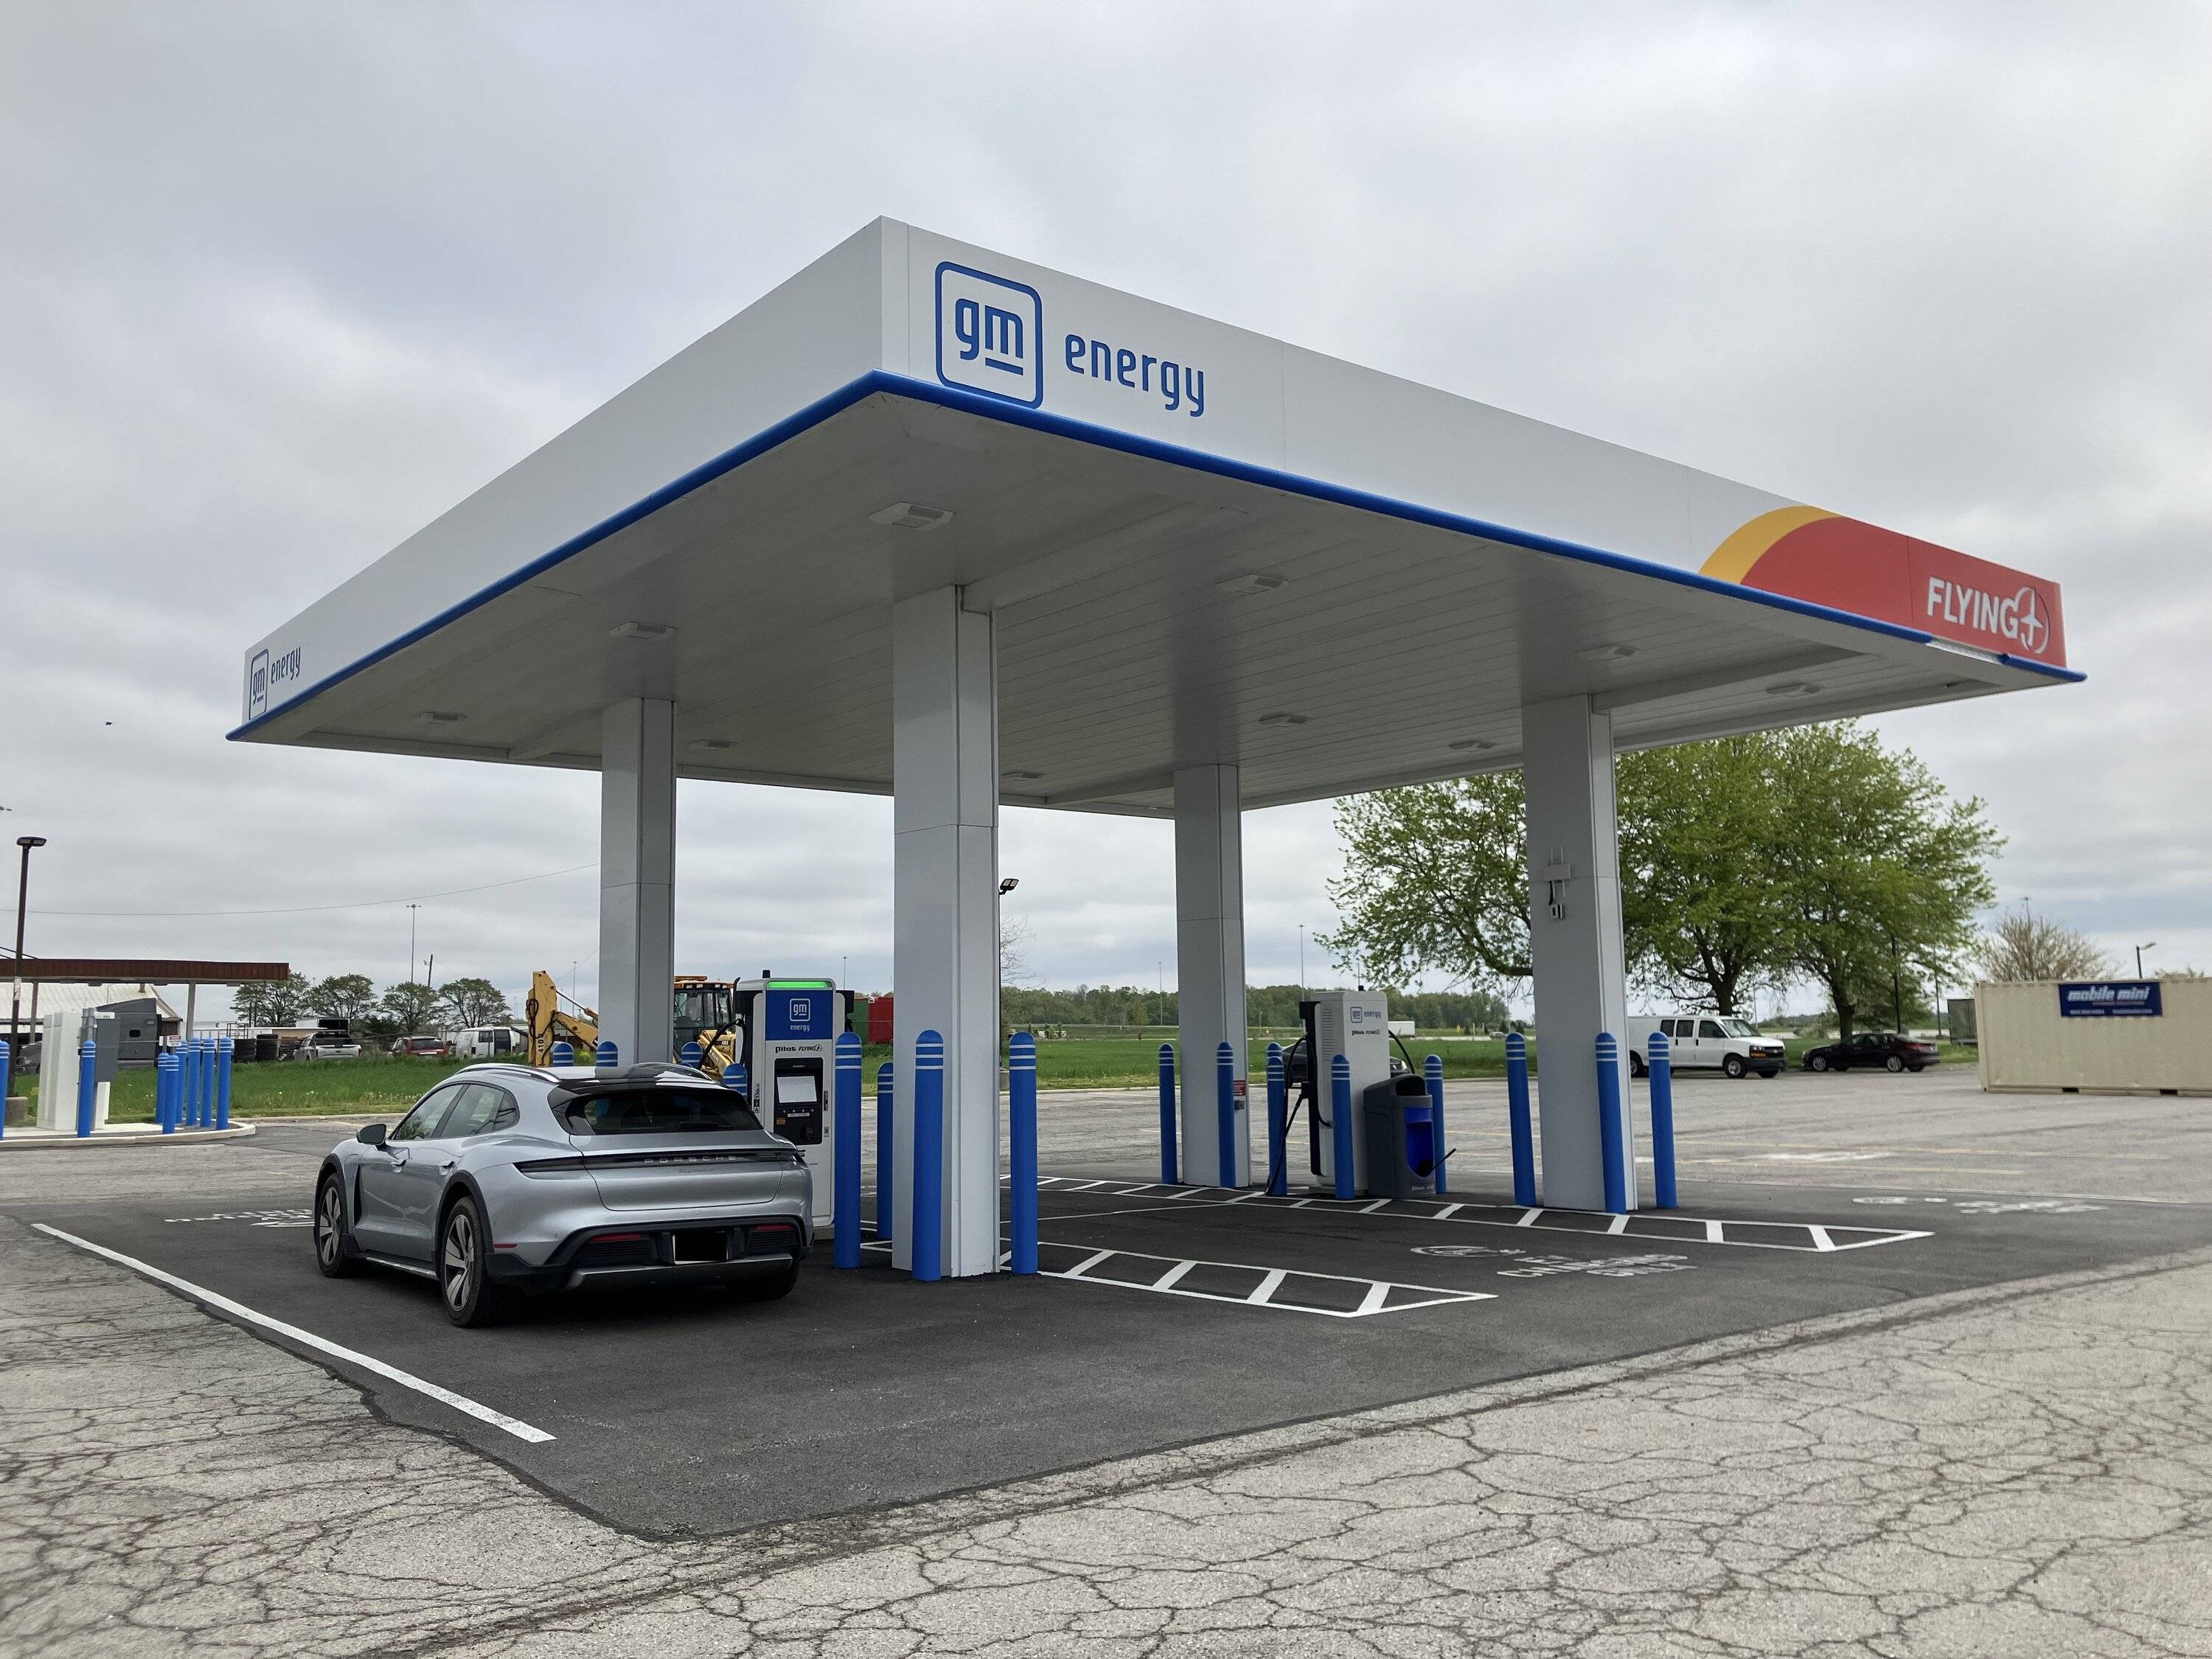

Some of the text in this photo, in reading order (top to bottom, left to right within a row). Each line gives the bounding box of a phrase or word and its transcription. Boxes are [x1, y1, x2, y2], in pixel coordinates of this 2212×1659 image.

[955, 298, 1205, 417] gm energy
[1927, 577, 2019, 640] FLYING
[253, 647, 301, 705] gm energy
[2067, 985, 2151, 1002] mobile mini
[793, 1004, 807, 1016] gm
[790, 1024, 810, 1032] energy
[644, 1155, 737, 1165] PORSCHE
